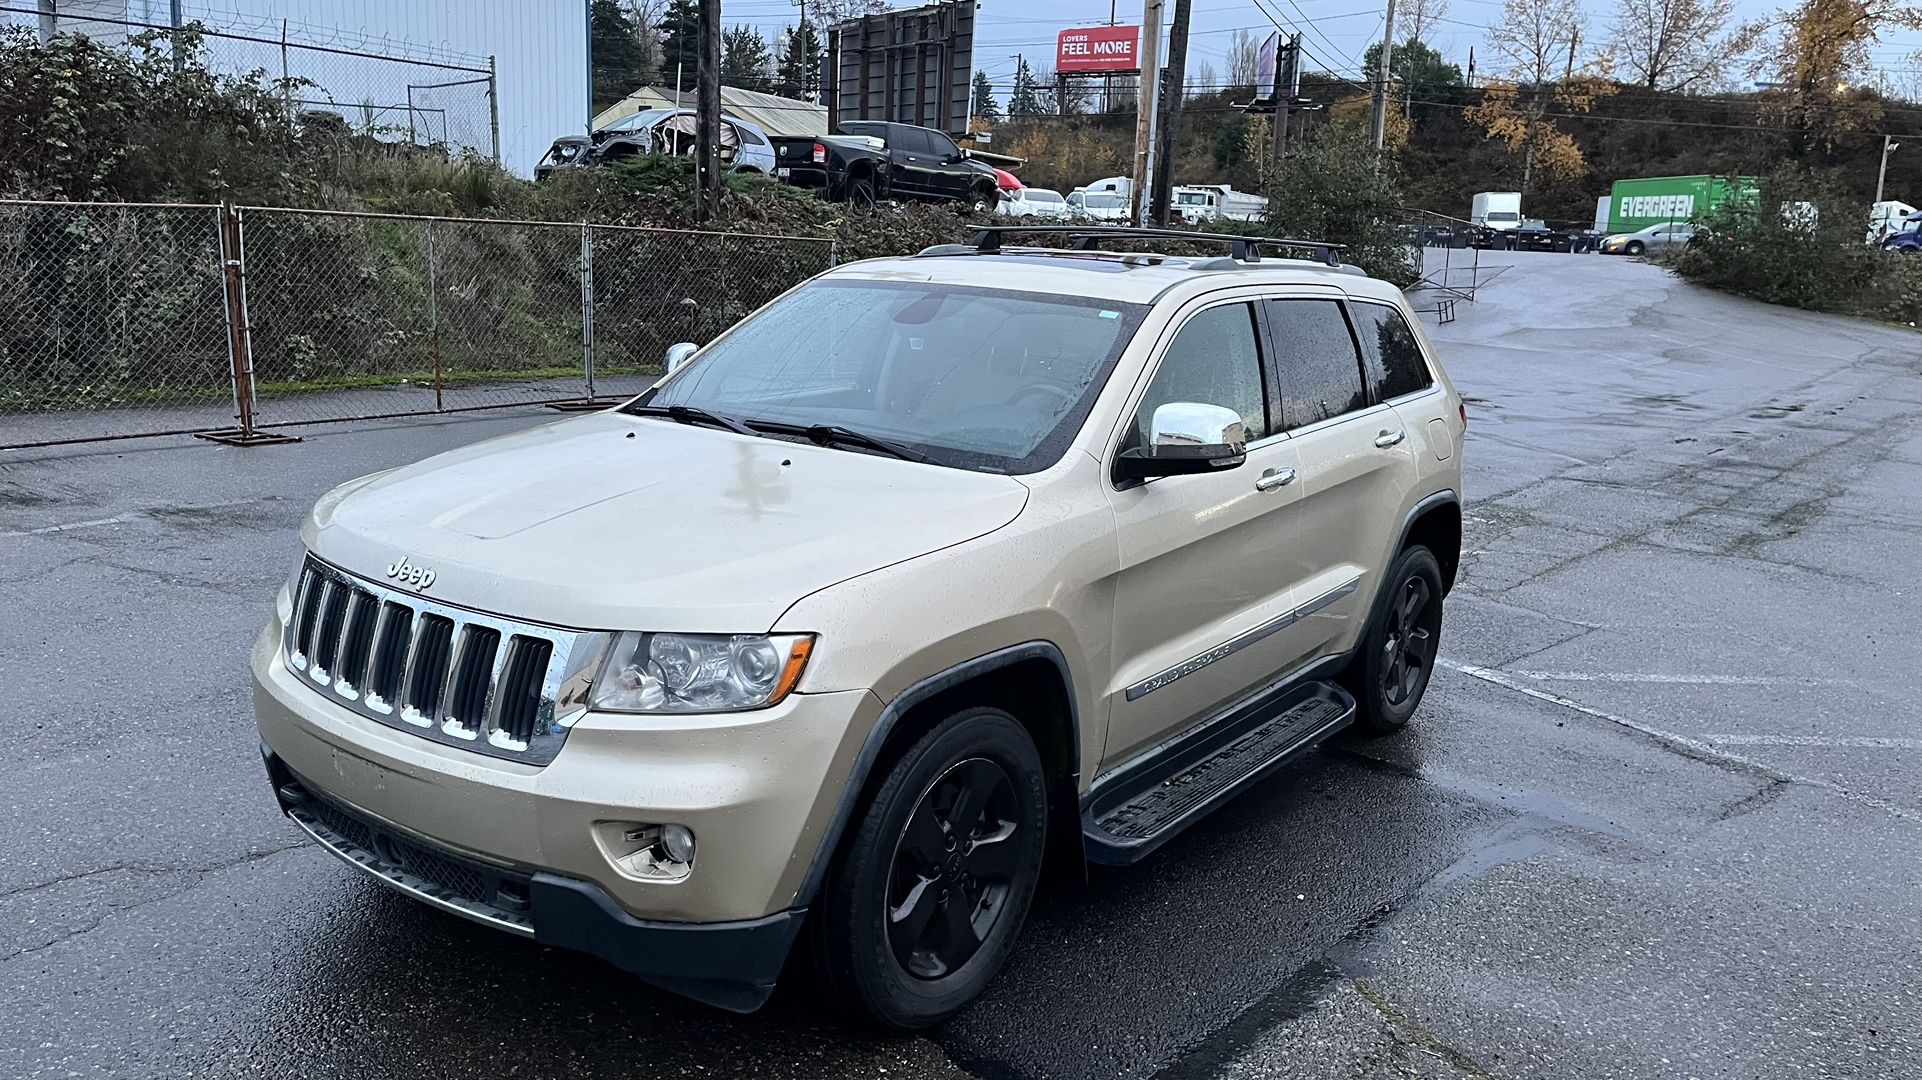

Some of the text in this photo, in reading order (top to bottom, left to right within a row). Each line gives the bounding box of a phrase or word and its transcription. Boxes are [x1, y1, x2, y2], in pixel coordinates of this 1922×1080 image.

[1062, 41, 1131, 55] FEEL MORE
[1619, 195, 1694, 217] EVERGREEN
[387, 555, 436, 592] Jeep
